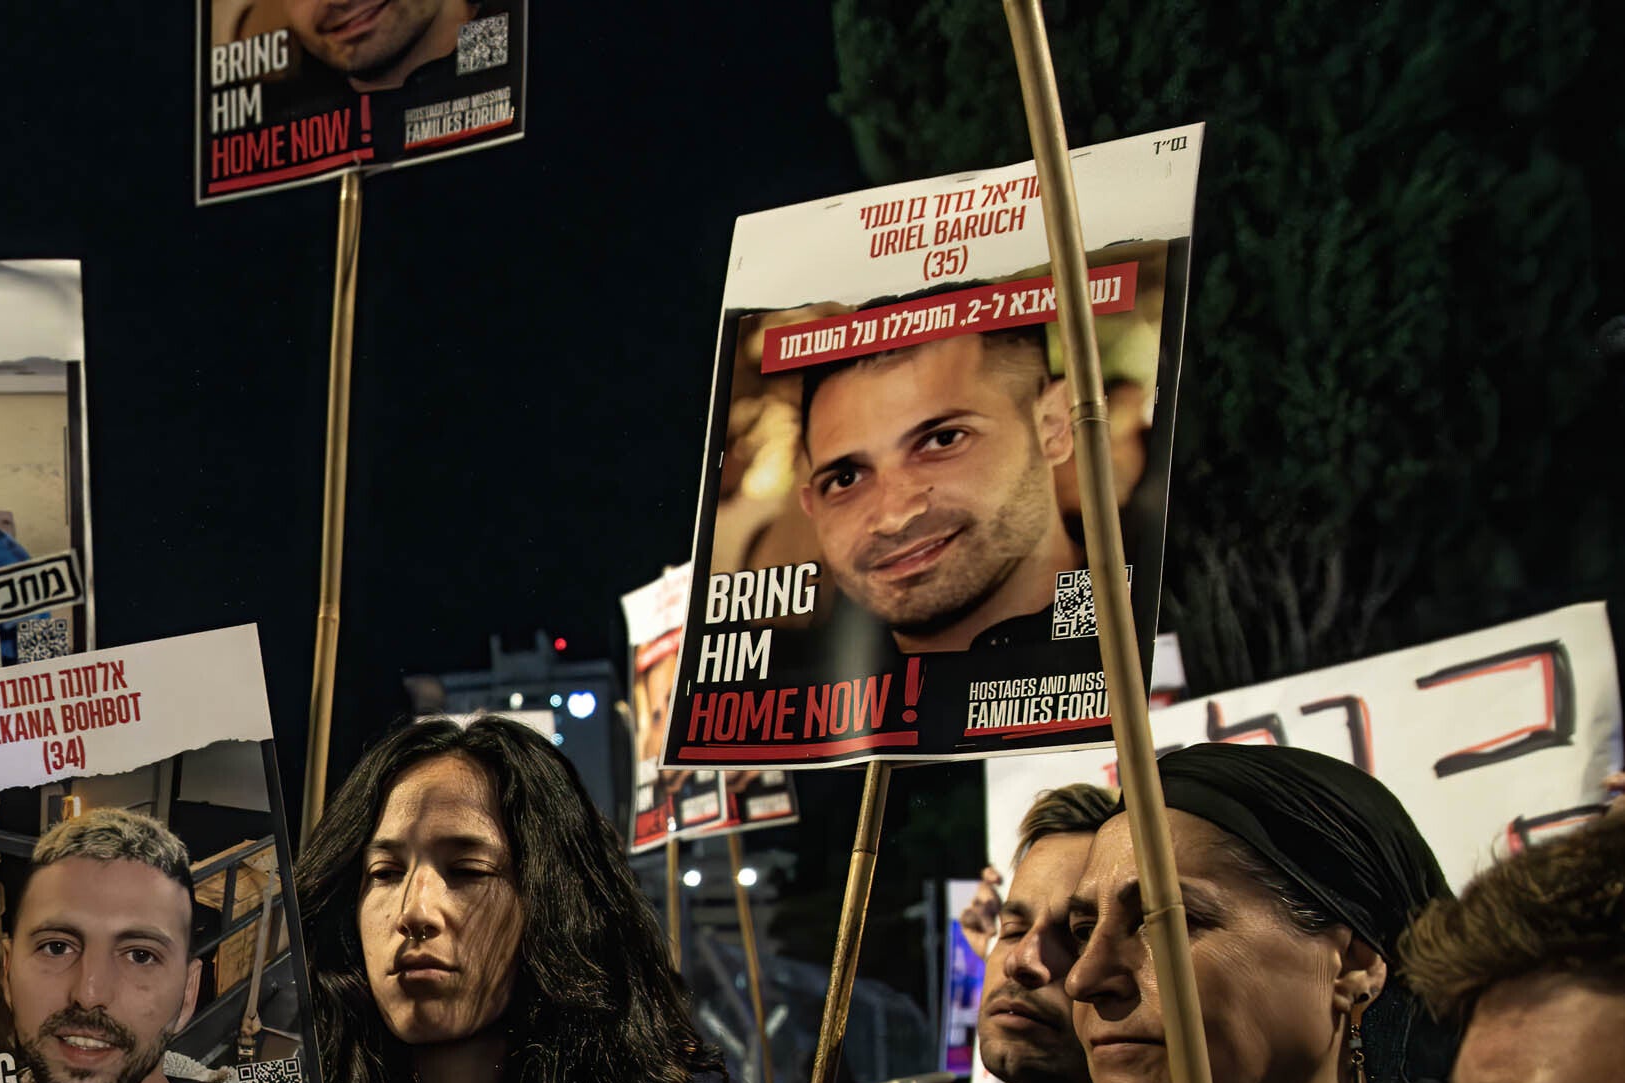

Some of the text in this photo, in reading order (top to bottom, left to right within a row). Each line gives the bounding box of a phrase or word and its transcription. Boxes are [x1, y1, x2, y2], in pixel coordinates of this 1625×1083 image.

[211, 29, 289, 86] BRING
[211, 83, 262, 134] HIM
[406, 100, 511, 144] FAMILIES FORUM
[211, 125, 285, 180] HOME
[860, 175, 1041, 230] וריאל ברוך בן נעמי
[870, 205, 1027, 259] URIEL BARUCH
[923, 245, 968, 280] (35)
[853, 319, 876, 348] על
[882, 304, 955, 338] התפללו
[705, 562, 817, 625] BRING
[696, 629, 772, 684] HIM
[59, 660, 128, 700] אלקנה
[969, 671, 1106, 700] HOSTAGES AND MISS
[62, 692, 142, 732] BOHBOT
[687, 687, 799, 742] HOME
[967, 691, 1111, 729] FAMILIES FORU
[43, 736, 86, 774] (34)
